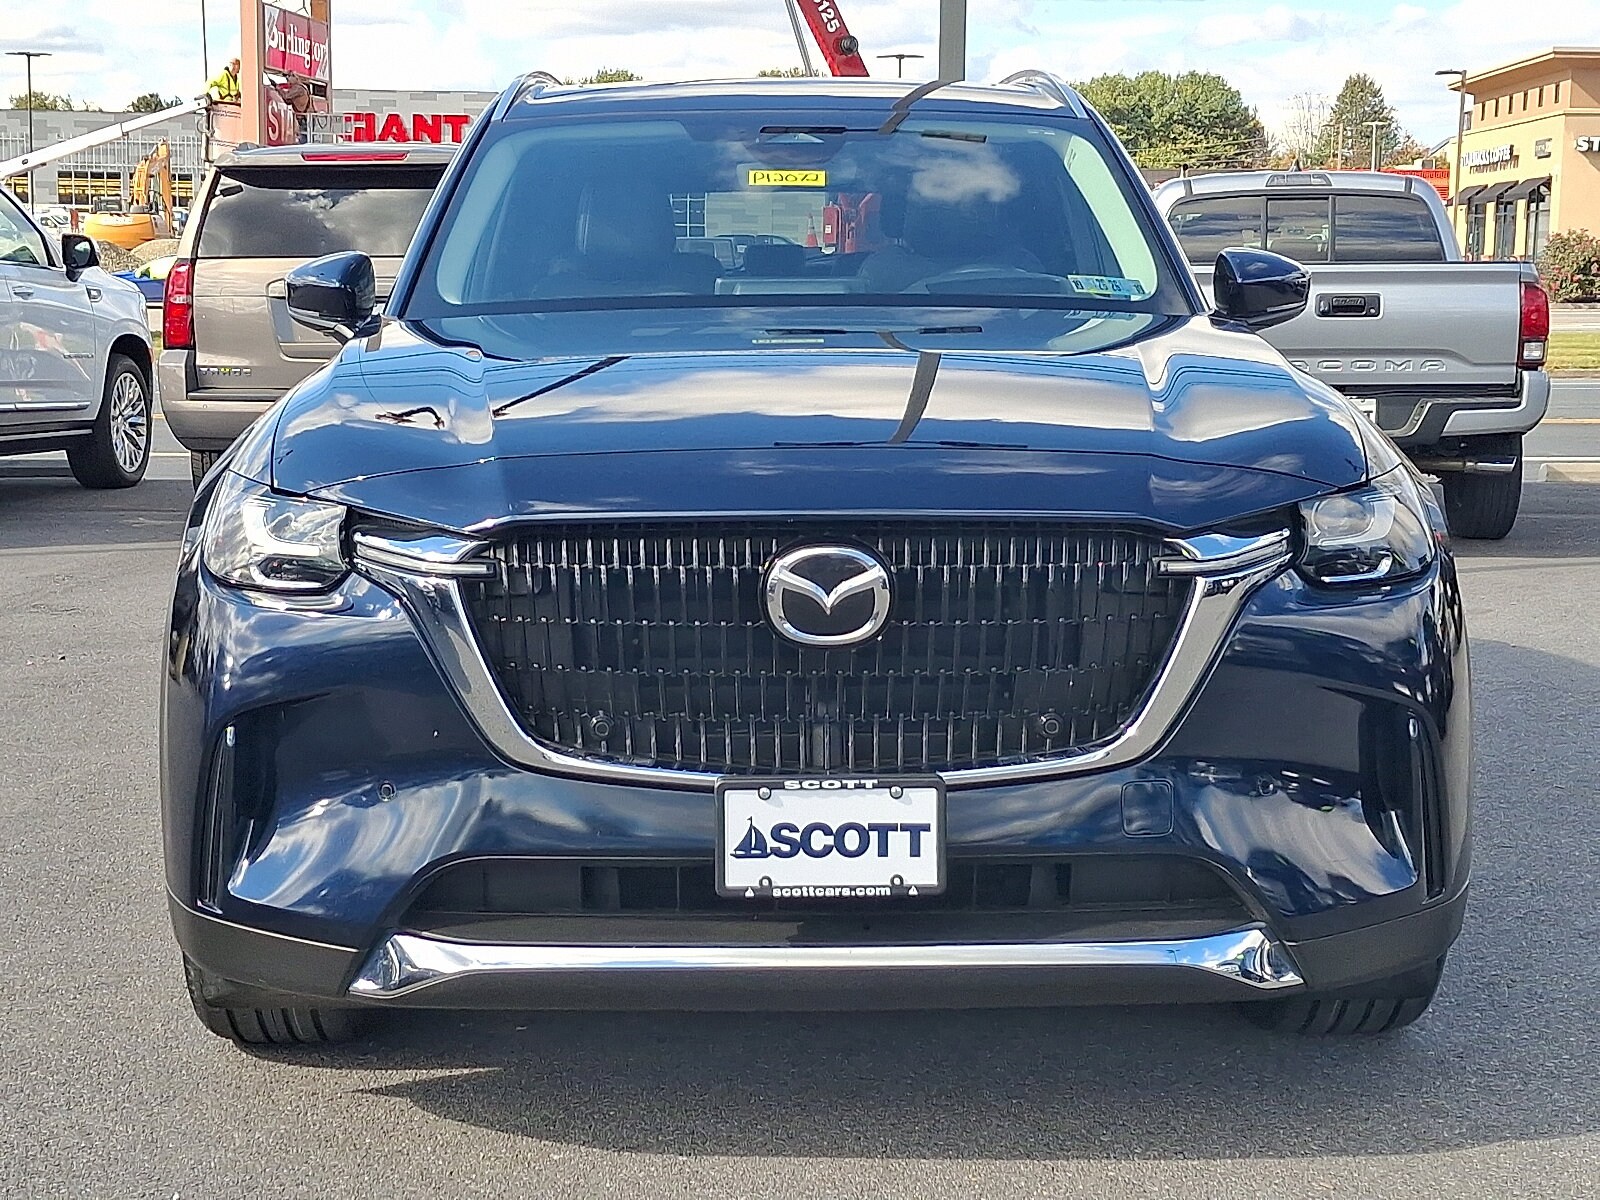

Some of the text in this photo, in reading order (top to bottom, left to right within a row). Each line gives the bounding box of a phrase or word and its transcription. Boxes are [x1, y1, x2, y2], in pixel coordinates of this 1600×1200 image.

[815, 0, 841, 33] 125
[1290, 359, 1447, 372] ACOMA
[783, 779, 879, 790] SCOTT
[770, 822, 931, 858] SCOTT
[772, 885, 891, 897] scottcars.com
